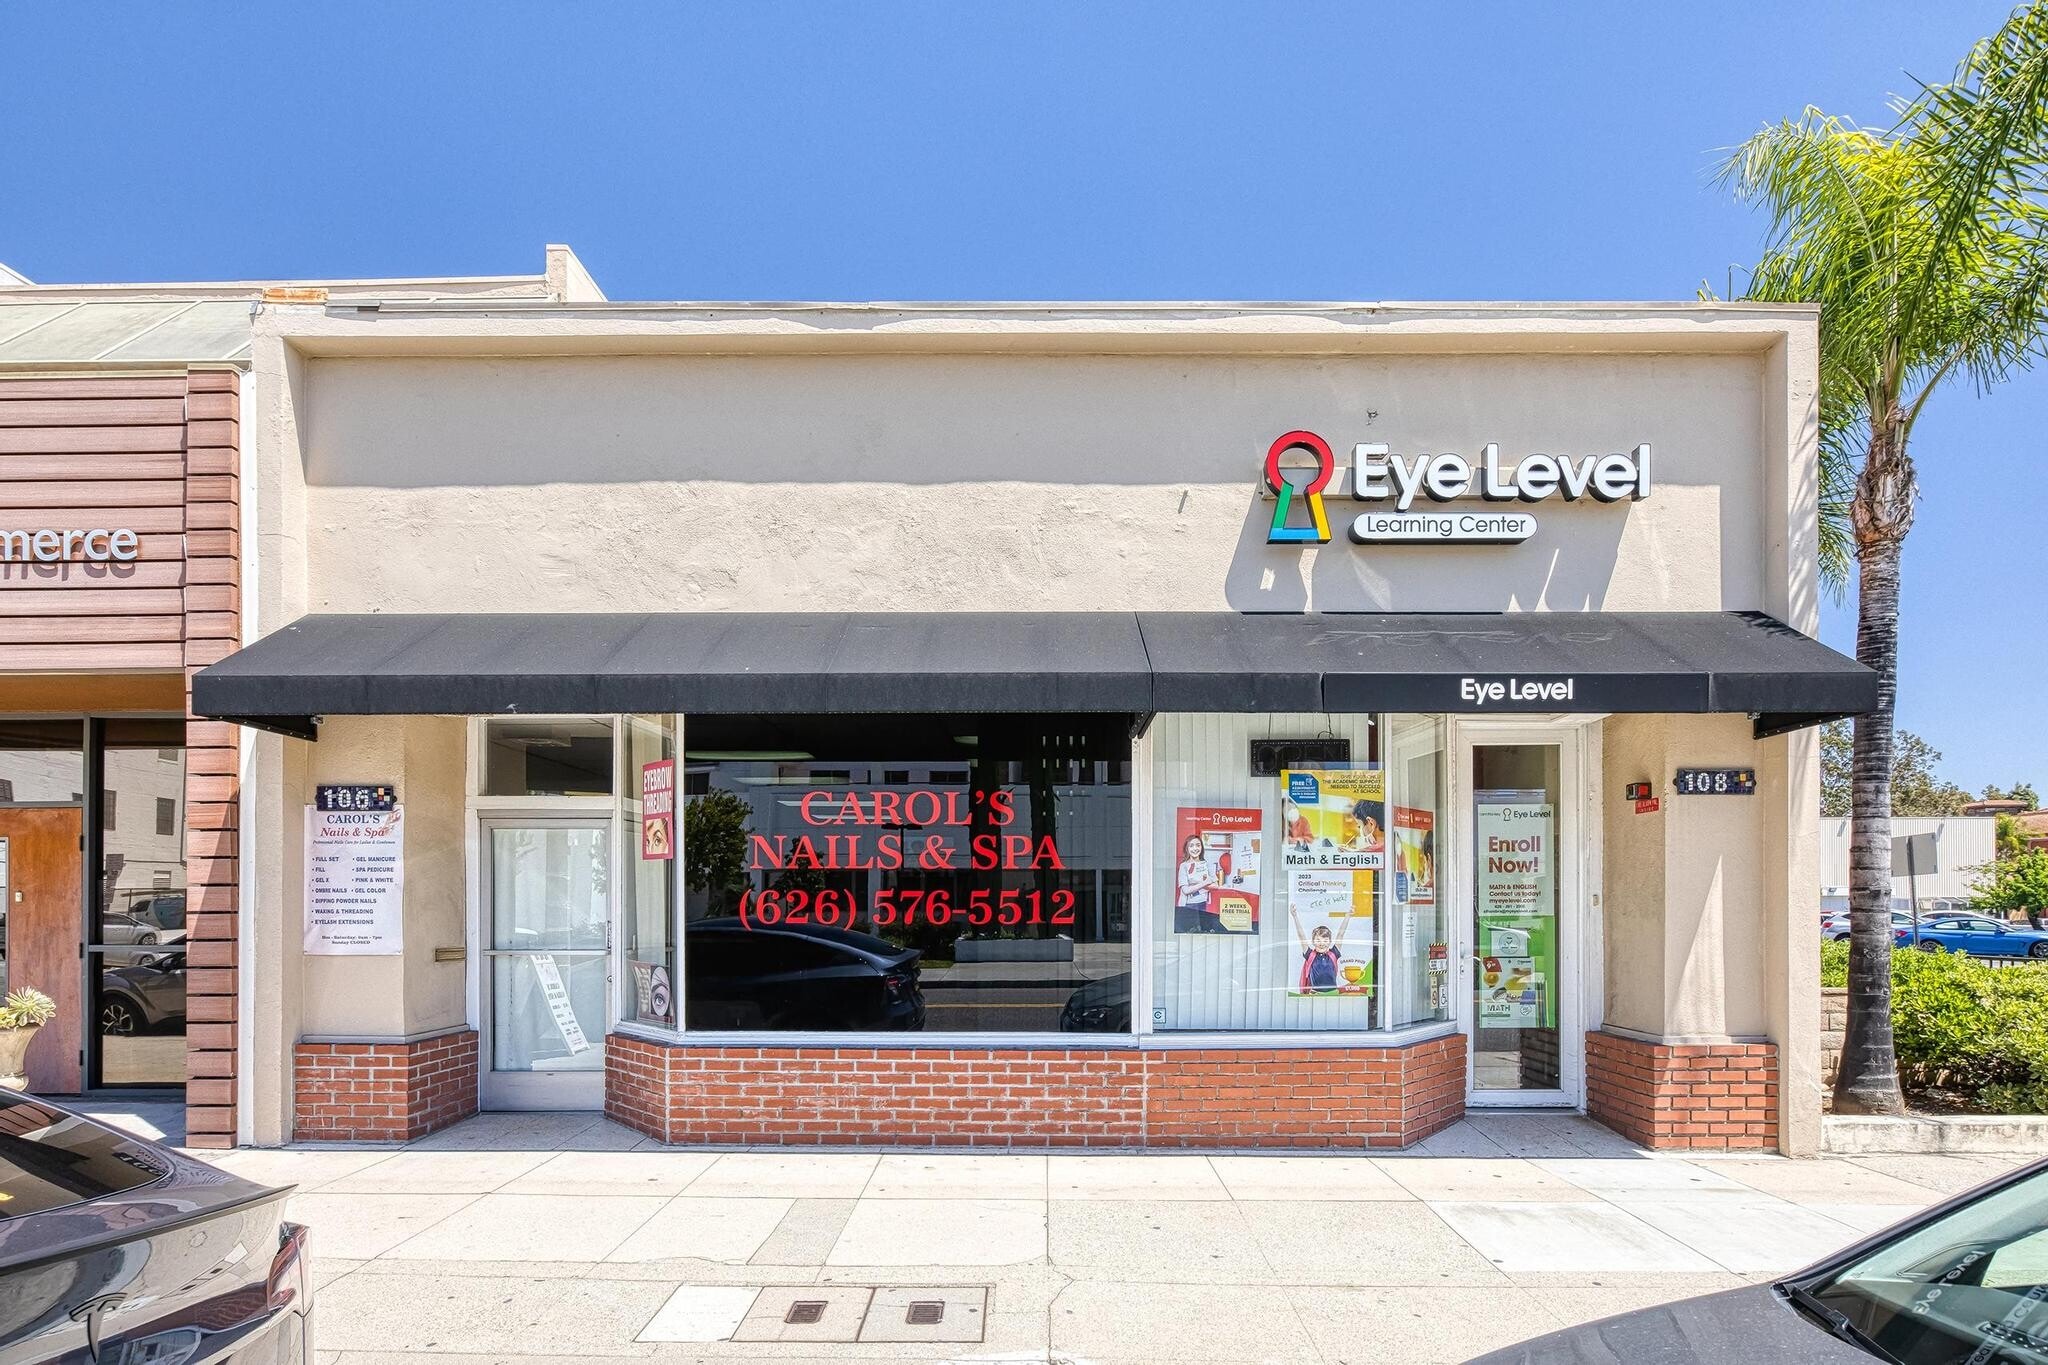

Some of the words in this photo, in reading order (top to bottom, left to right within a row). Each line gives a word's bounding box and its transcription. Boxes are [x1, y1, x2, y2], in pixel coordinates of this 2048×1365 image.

[1352, 442, 1471, 512] Eye
[1482, 442, 1652, 502] Level
[1367, 516, 1452, 536] Learning
[1459, 515, 1526, 534] Center
[0, 528, 138, 561] merce
[1461, 678, 1505, 705] Eye
[1510, 678, 1574, 700] Level
[643, 765, 672, 792] EYEBROW
[1685, 772, 1728, 792] 108
[324, 789, 369, 808] 106
[643, 790, 672, 815] THREADING
[801, 790, 1015, 826] CAROL'S
[326, 814, 381, 824] CAROL'S
[1221, 815, 1234, 824] Eye
[1235, 815, 1252, 823] Level
[1514, 811, 1528, 820] Eye
[1530, 810, 1551, 818] Level
[320, 827, 350, 837] Nails
[352, 827, 361, 837] &
[364, 827, 385, 839] Spa
[749, 834, 903, 870] NAILS
[919, 834, 957, 870] &
[971, 834, 1067, 870] SPA
[1489, 836, 1541, 852] Enroll
[1286, 854, 1316, 865] Math
[1320, 854, 1328, 865] &
[1333, 854, 1379, 867] English
[1489, 857, 1538, 873] Now!
[739, 888, 857, 932] (626)
[872, 888, 1076, 926] 576-5512
